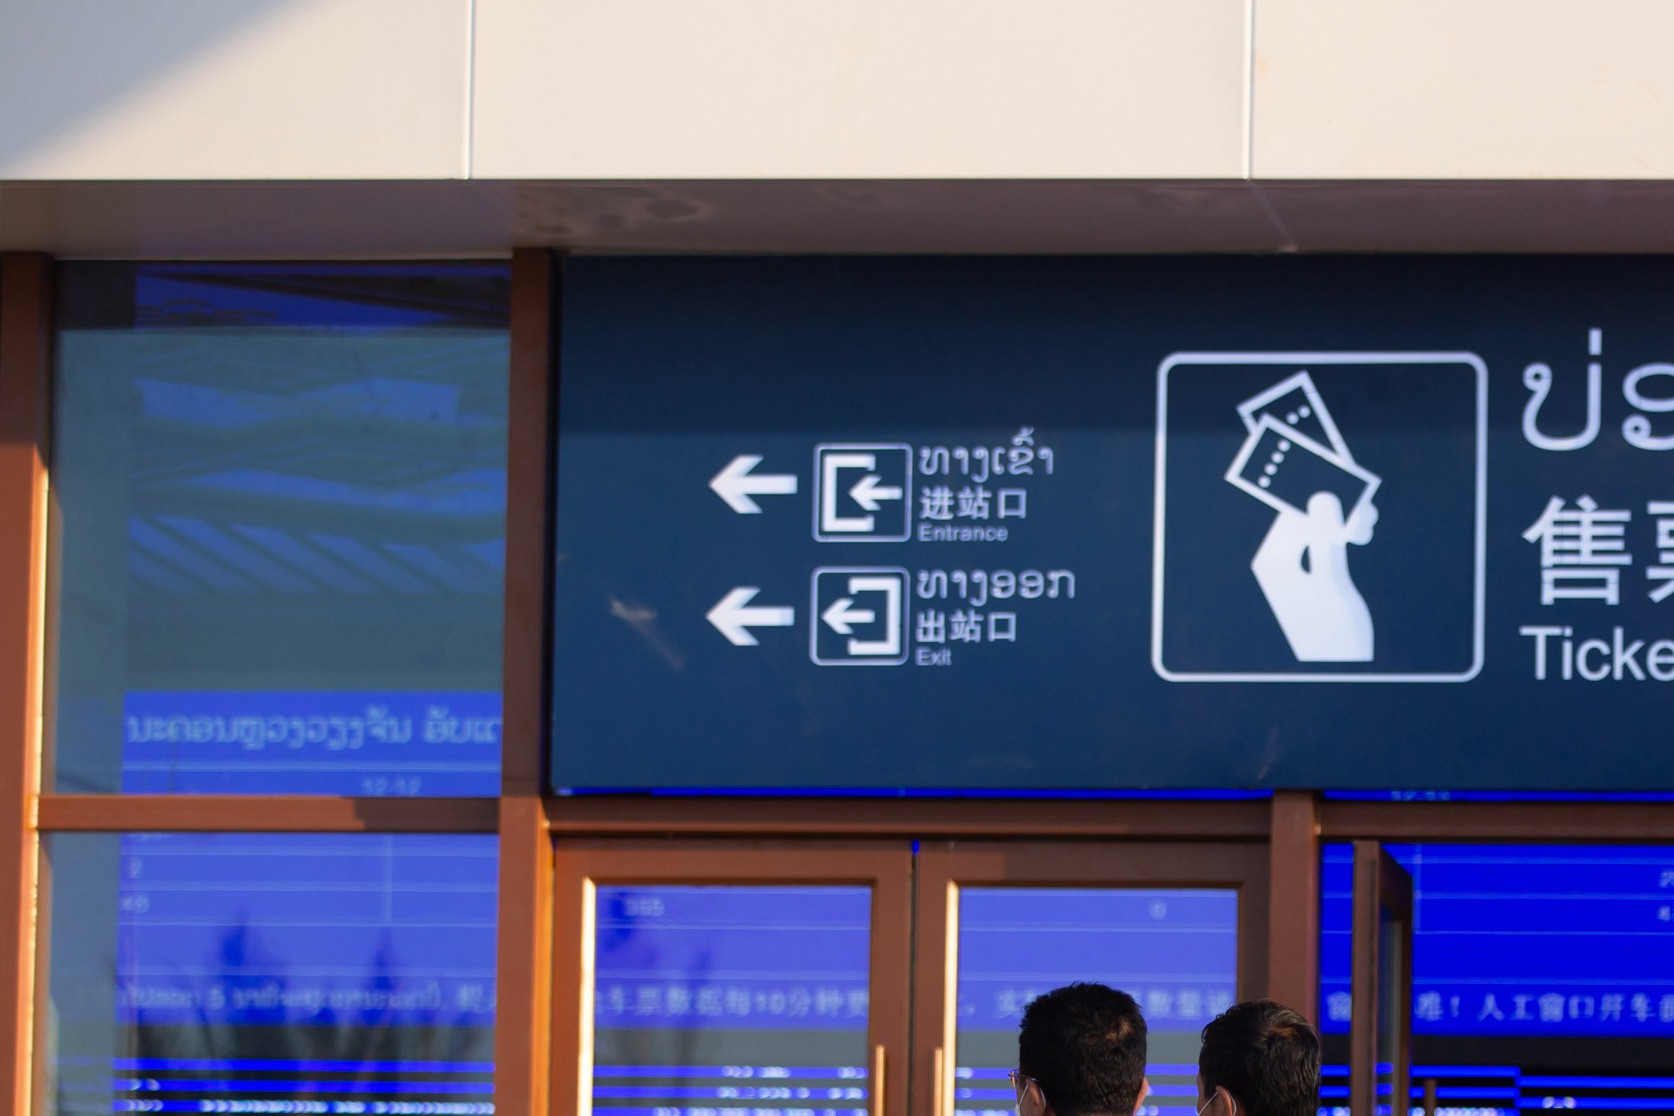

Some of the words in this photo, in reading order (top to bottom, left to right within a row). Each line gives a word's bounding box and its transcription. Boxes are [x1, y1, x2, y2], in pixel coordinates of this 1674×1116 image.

[919, 426, 1054, 482] ທາງເຂົ້າ
[920, 486, 1027, 520] 进站口
[918, 524, 1009, 542] Entrance
[916, 569, 1076, 606] ທາງອອກ
[915, 608, 1017, 643] 出站口
[915, 647, 952, 666] Exit
